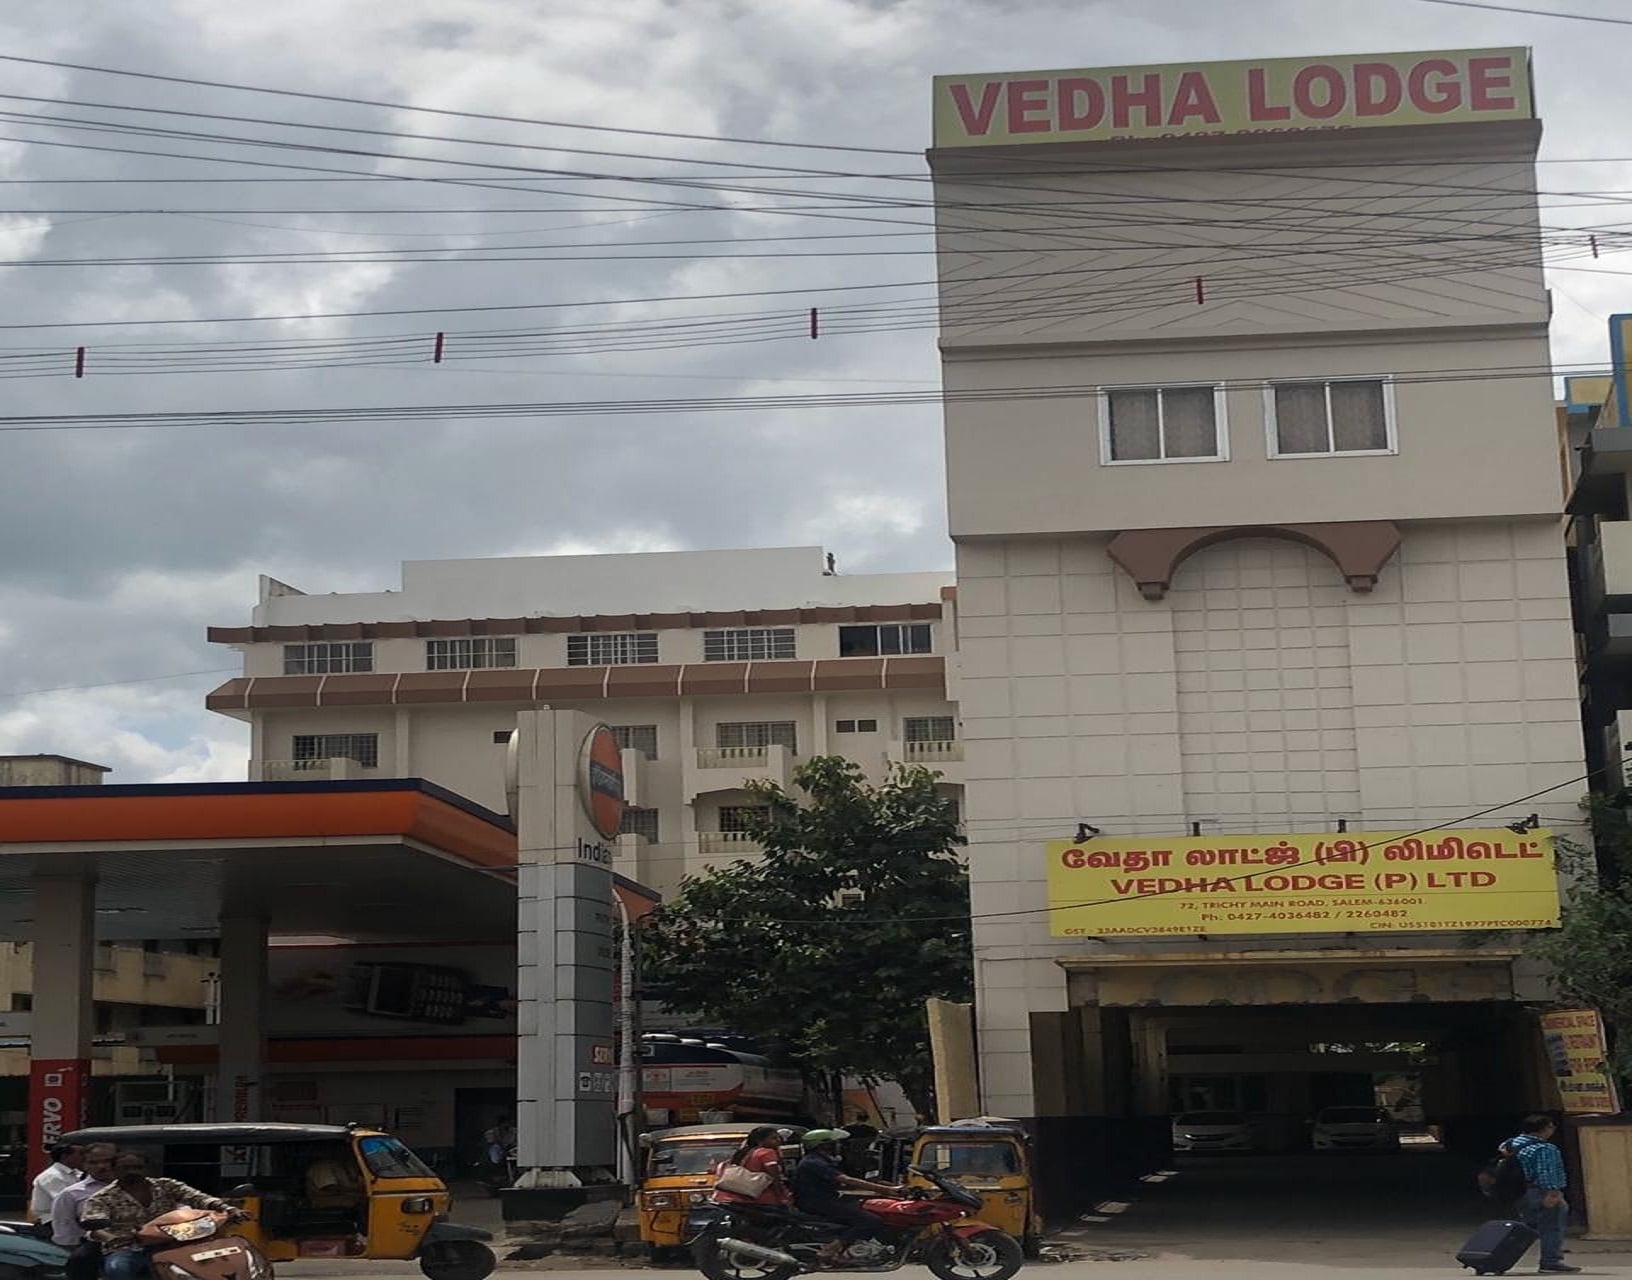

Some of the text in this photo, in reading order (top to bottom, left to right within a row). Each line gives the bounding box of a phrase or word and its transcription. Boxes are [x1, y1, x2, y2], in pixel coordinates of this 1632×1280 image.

[948, 56, 1517, 137] VEDHA LODGE
[1061, 837, 1544, 873] வேதா லாட்ஜ் (பி) லிமிடெட்
[1110, 871, 1497, 895] VEDHA LODGE (P) LTD
[1202, 901, 1247, 910] TRICHY
[1250, 900, 1285, 909] MAIN
[1346, 910, 1408, 919] 2260482
